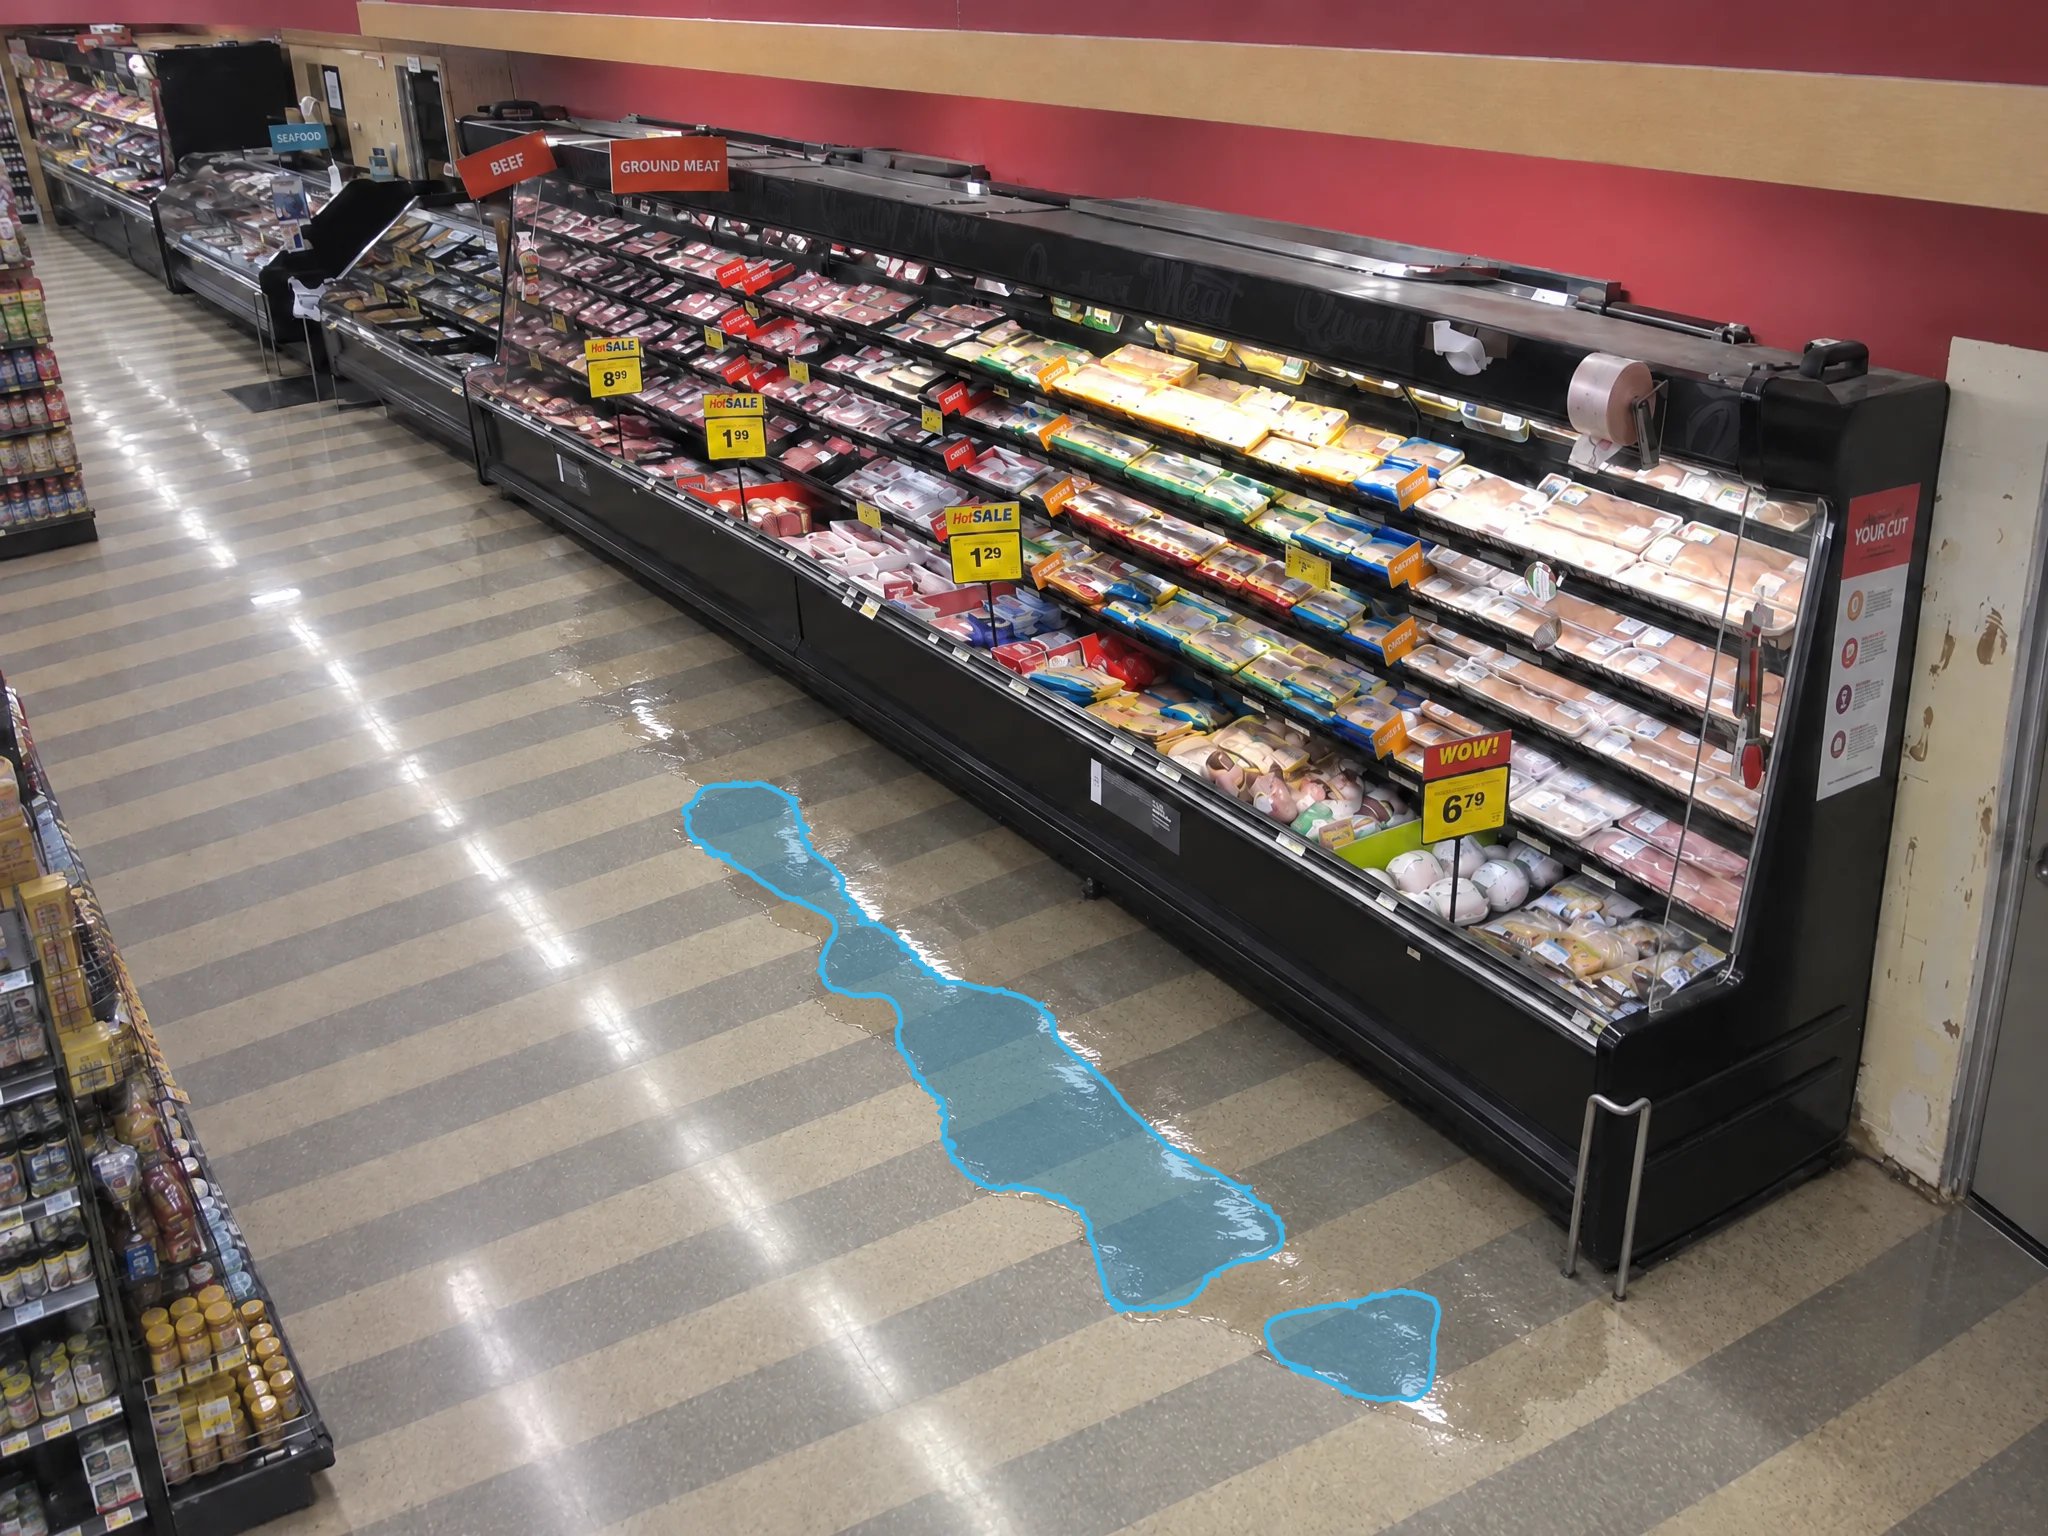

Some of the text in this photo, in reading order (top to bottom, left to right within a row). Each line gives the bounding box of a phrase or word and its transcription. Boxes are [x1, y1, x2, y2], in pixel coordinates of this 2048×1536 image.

[276, 131, 322, 144] SEAFOOD
[490, 152, 525, 176] BEEF
[620, 159, 721, 174] GROUND MEAT
[952, 507, 1012, 525] HotSALE
[1855, 516, 1909, 546] YOUR CUT
[1439, 736, 1500, 766] WOW!
